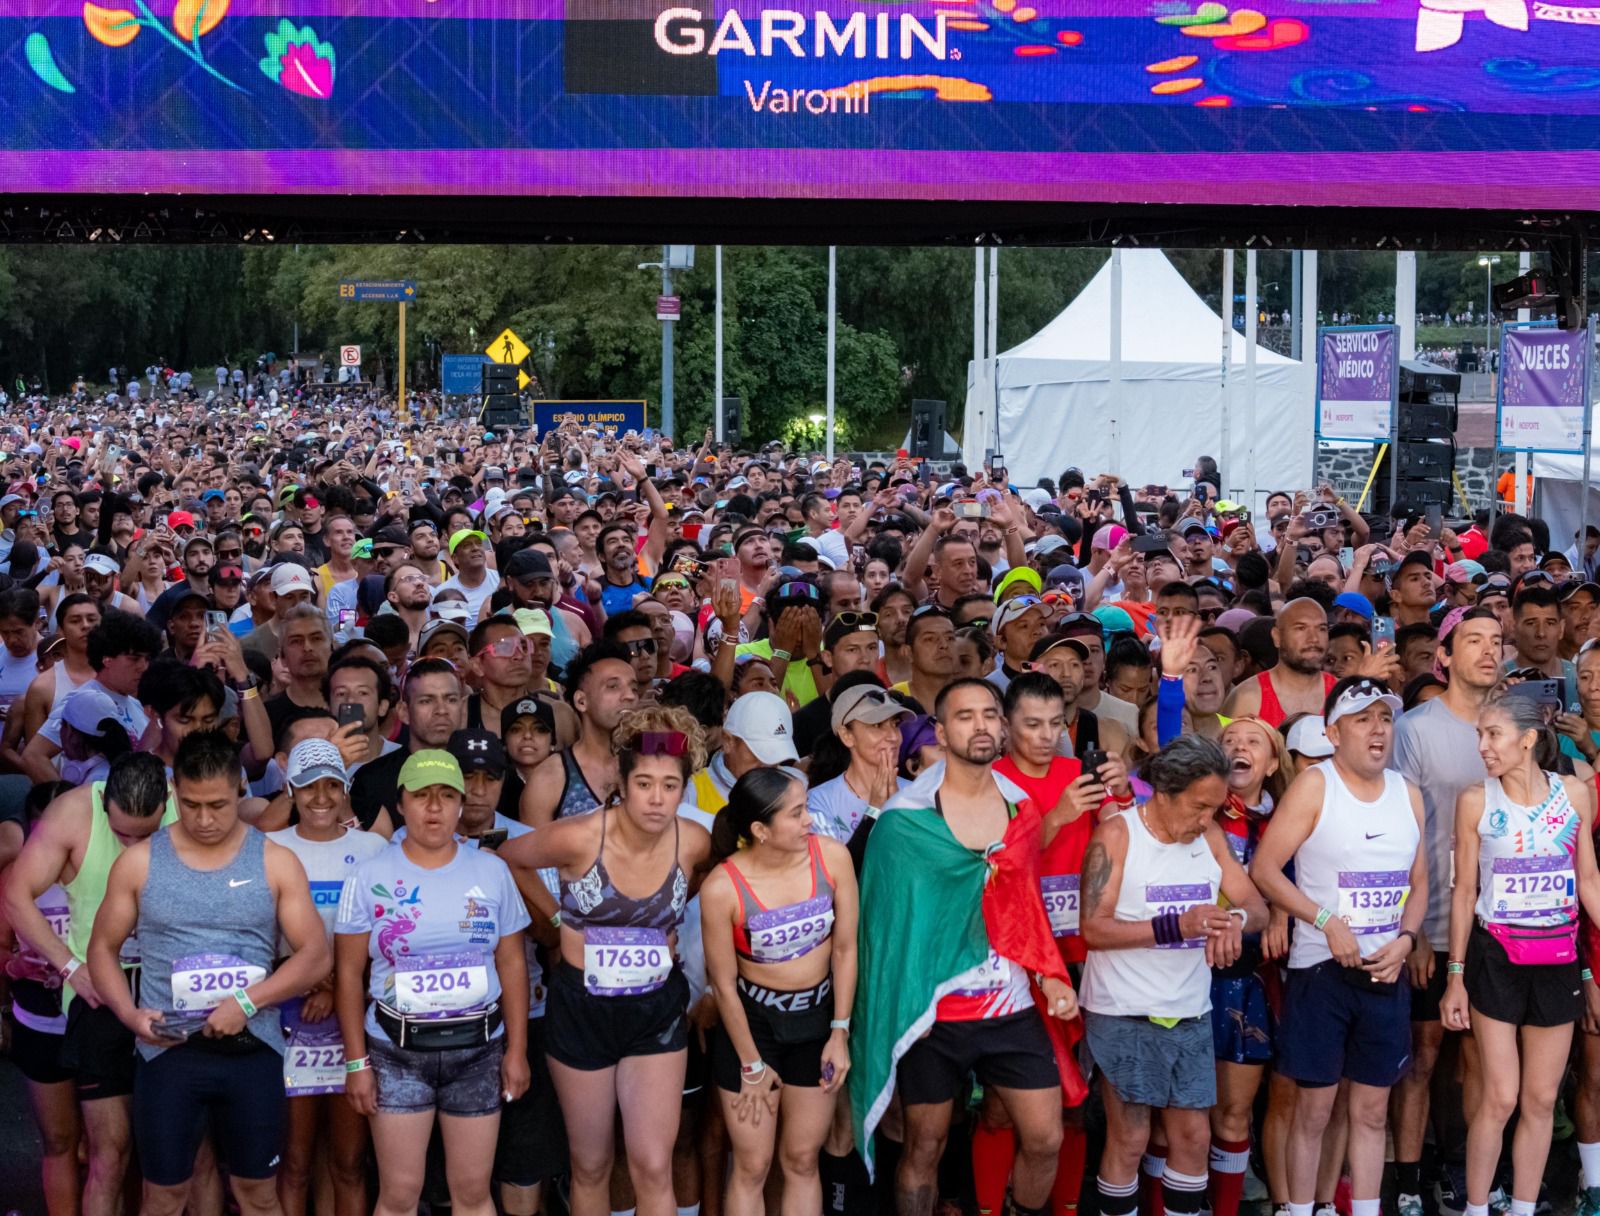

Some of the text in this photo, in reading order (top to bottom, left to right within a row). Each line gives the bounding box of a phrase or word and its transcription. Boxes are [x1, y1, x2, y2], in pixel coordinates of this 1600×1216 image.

[654, 7, 947, 60] GARMIN
[744, 80, 870, 114] Varonil
[340, 284, 355, 297] E8
[1336, 334, 1379, 353] SERVICIO
[1338, 354, 1375, 378] MÉDICO
[1520, 343, 1570, 370] JUECES
[1505, 874, 1566, 893] 21720
[1044, 894, 1078, 912] 592
[1348, 889, 1403, 908] 13320
[761, 918, 826, 947] 23293
[595, 948, 661, 967] 17630
[189, 970, 249, 993] 3205
[411, 971, 471, 993] 3204
[295, 1048, 345, 1068] 2722
